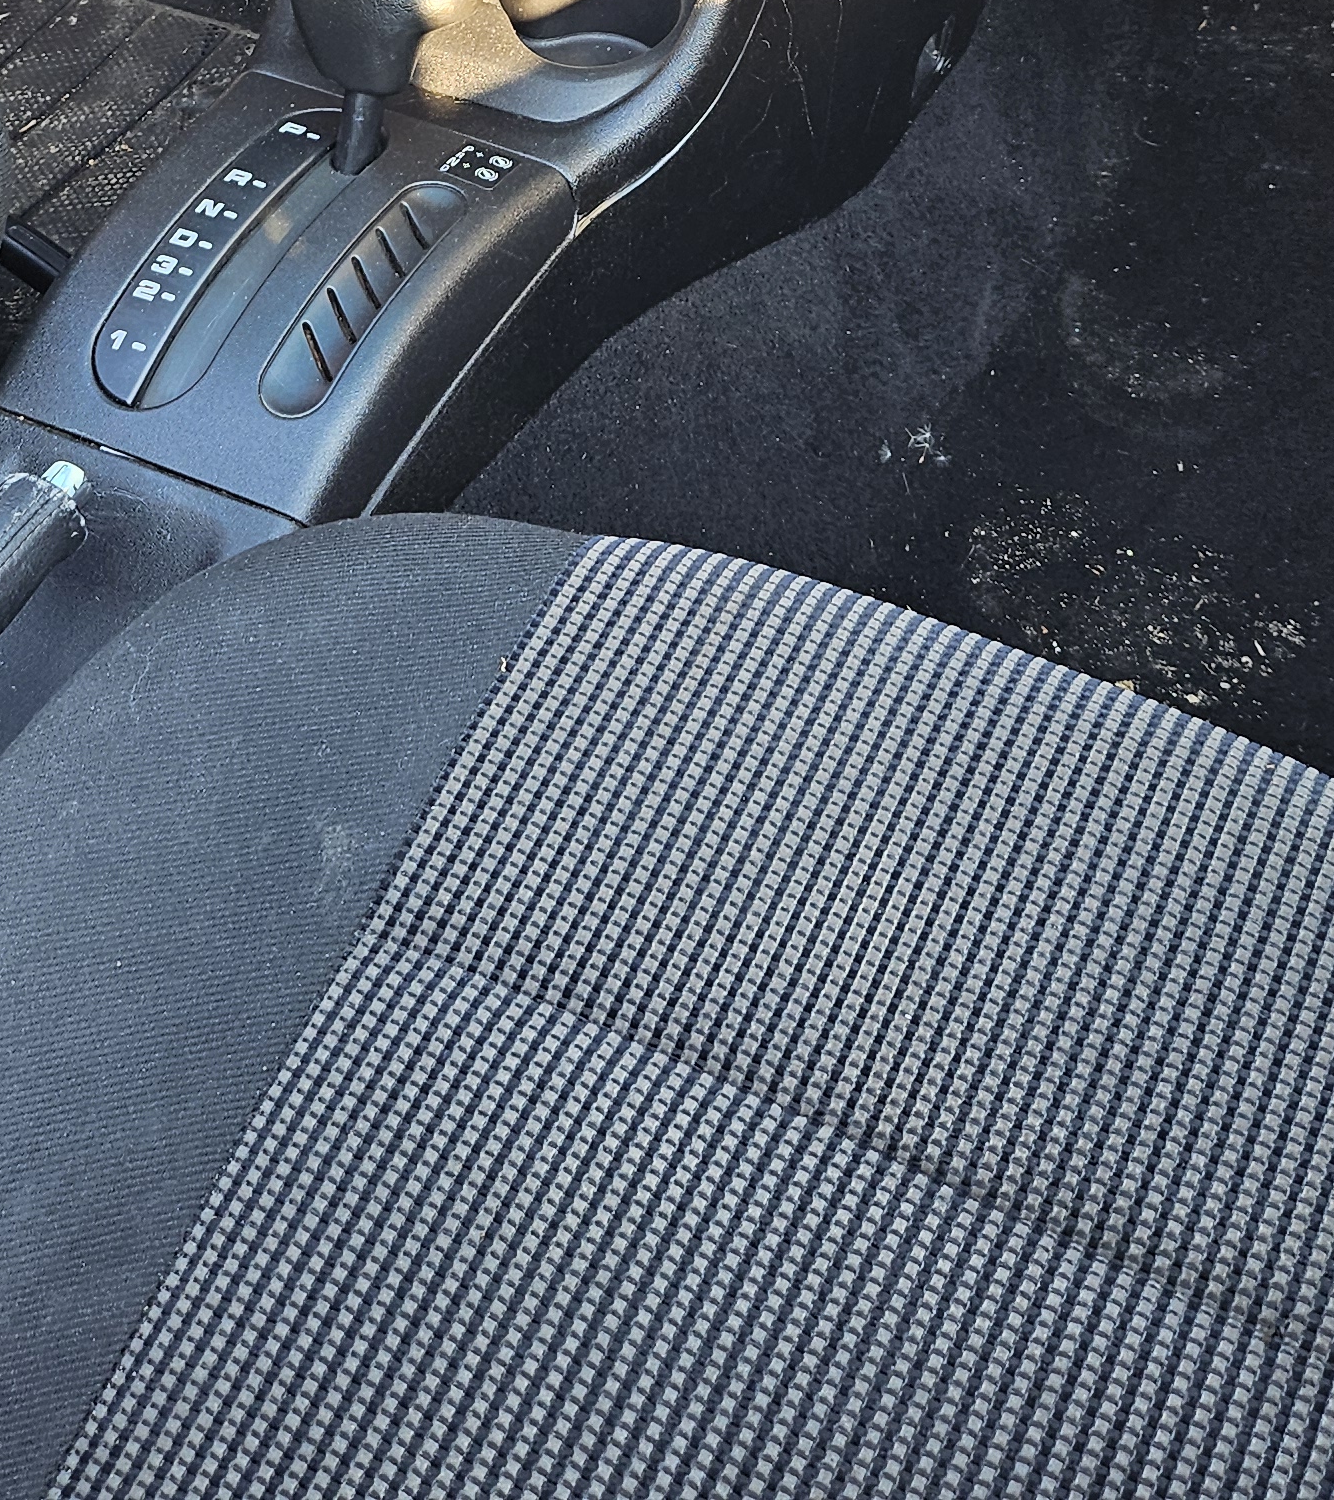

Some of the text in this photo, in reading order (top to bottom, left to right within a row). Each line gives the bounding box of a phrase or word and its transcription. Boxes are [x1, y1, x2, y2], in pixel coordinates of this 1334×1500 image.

[278, 121, 308, 140] P
[223, 168, 253, 188] R
[195, 198, 226, 218] N
[168, 227, 199, 248] D
[150, 254, 181, 275] 3
[132, 279, 162, 302] 2
[109, 329, 128, 351] 1
